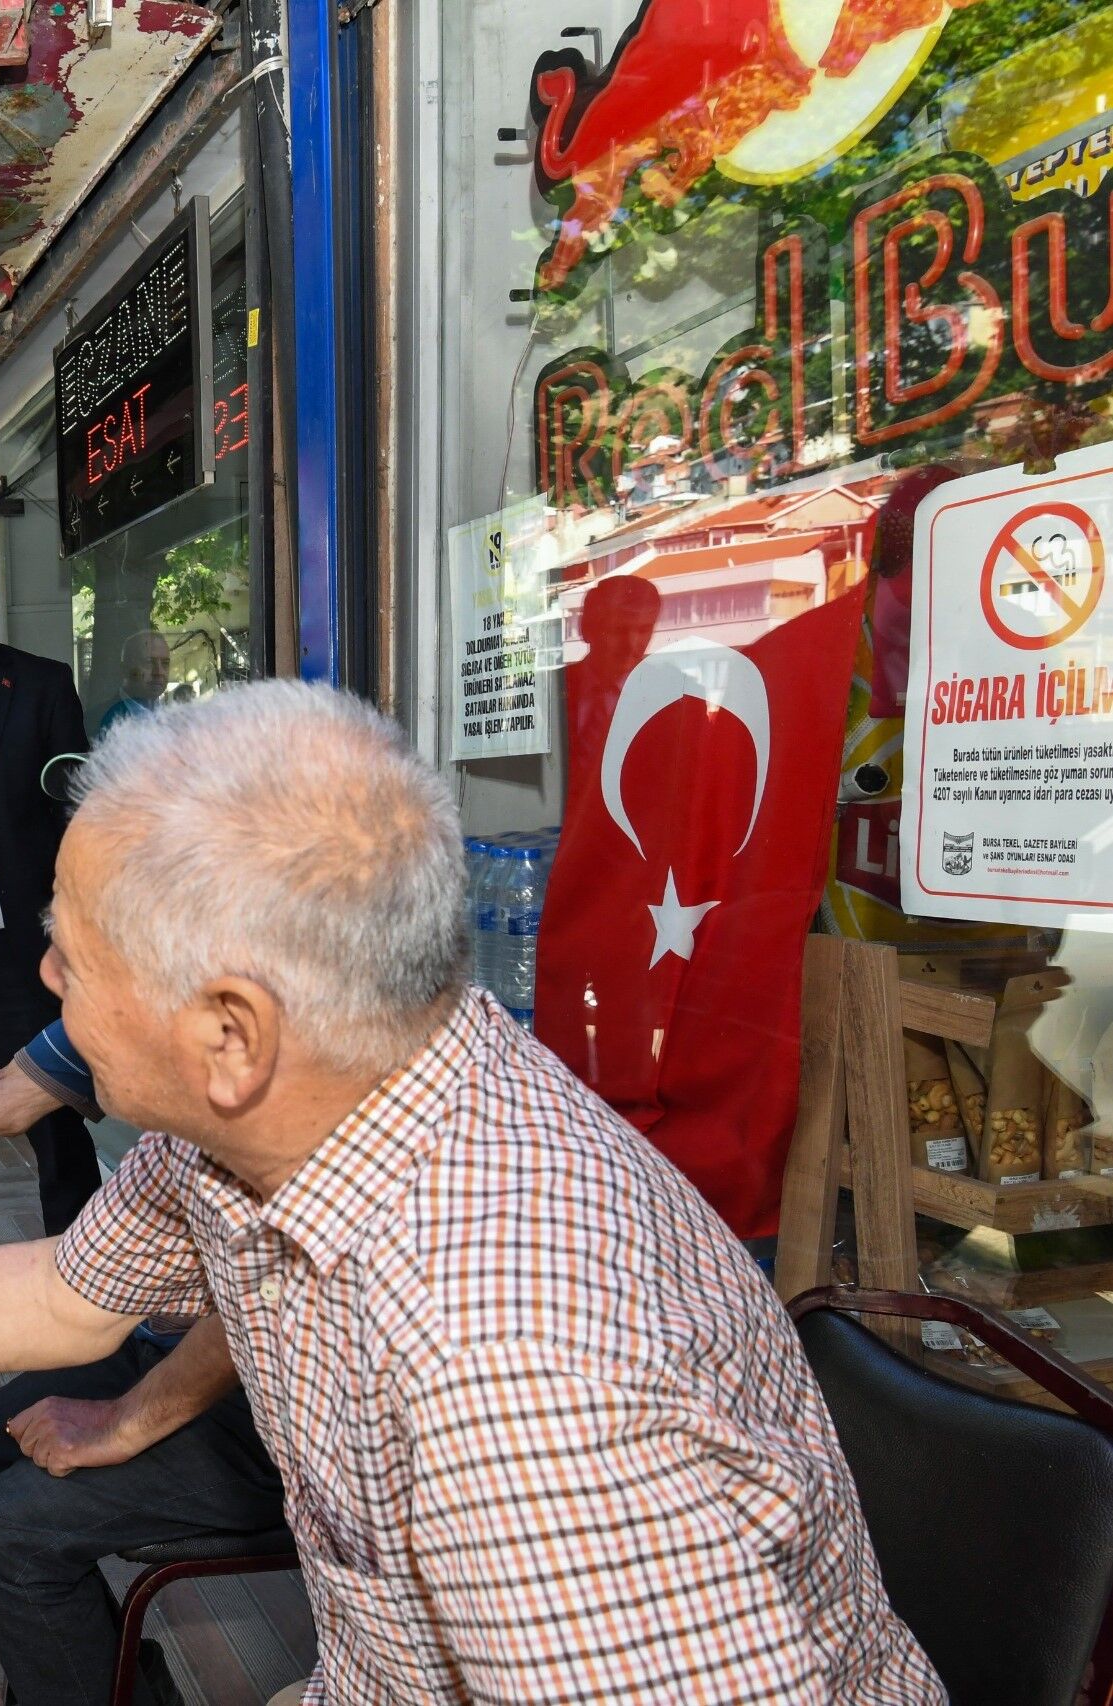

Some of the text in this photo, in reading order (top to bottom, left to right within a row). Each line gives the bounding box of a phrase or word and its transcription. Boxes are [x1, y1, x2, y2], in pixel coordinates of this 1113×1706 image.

[61, 241, 186, 435] ECZANE
[88, 383, 151, 484] ESAT
[483, 616, 491, 631] 18
[484, 657, 492, 672] VE
[465, 698, 496, 717] SATANLAR
[931, 672, 1025, 725] SİGARA
[464, 721, 482, 737] YASAL
[953, 748, 979, 762] Burada
[982, 747, 1001, 761] tütün
[1004, 745, 1033, 760] ürünleri
[1036, 743, 1081, 759] tüketilmesi
[934, 768, 977, 781] Tüketenlere
[980, 770, 988, 780] ve
[991, 765, 1041, 780] tüketilmesine
[1044, 765, 1059, 783] göz
[1060, 767, 1087, 783] yuman
[933, 787, 951, 800] 4207
[953, 787, 972, 804] sayılı
[975, 786, 997, 800] Kanun
[999, 789, 1031, 804] uyarınca
[1034, 785, 1052, 800] idari
[1055, 788, 1073, 804] para
[1076, 788, 1102, 800] cezası
[983, 838, 1001, 848] BURSA
[1023, 839, 1048, 849] GAZETE
[1050, 838, 1078, 850] BAYİLERİ
[1007, 852, 1036, 862] OYUNLARI
[1037, 853, 1056, 863] ESNAF
[1058, 854, 1076, 863] ODASI
